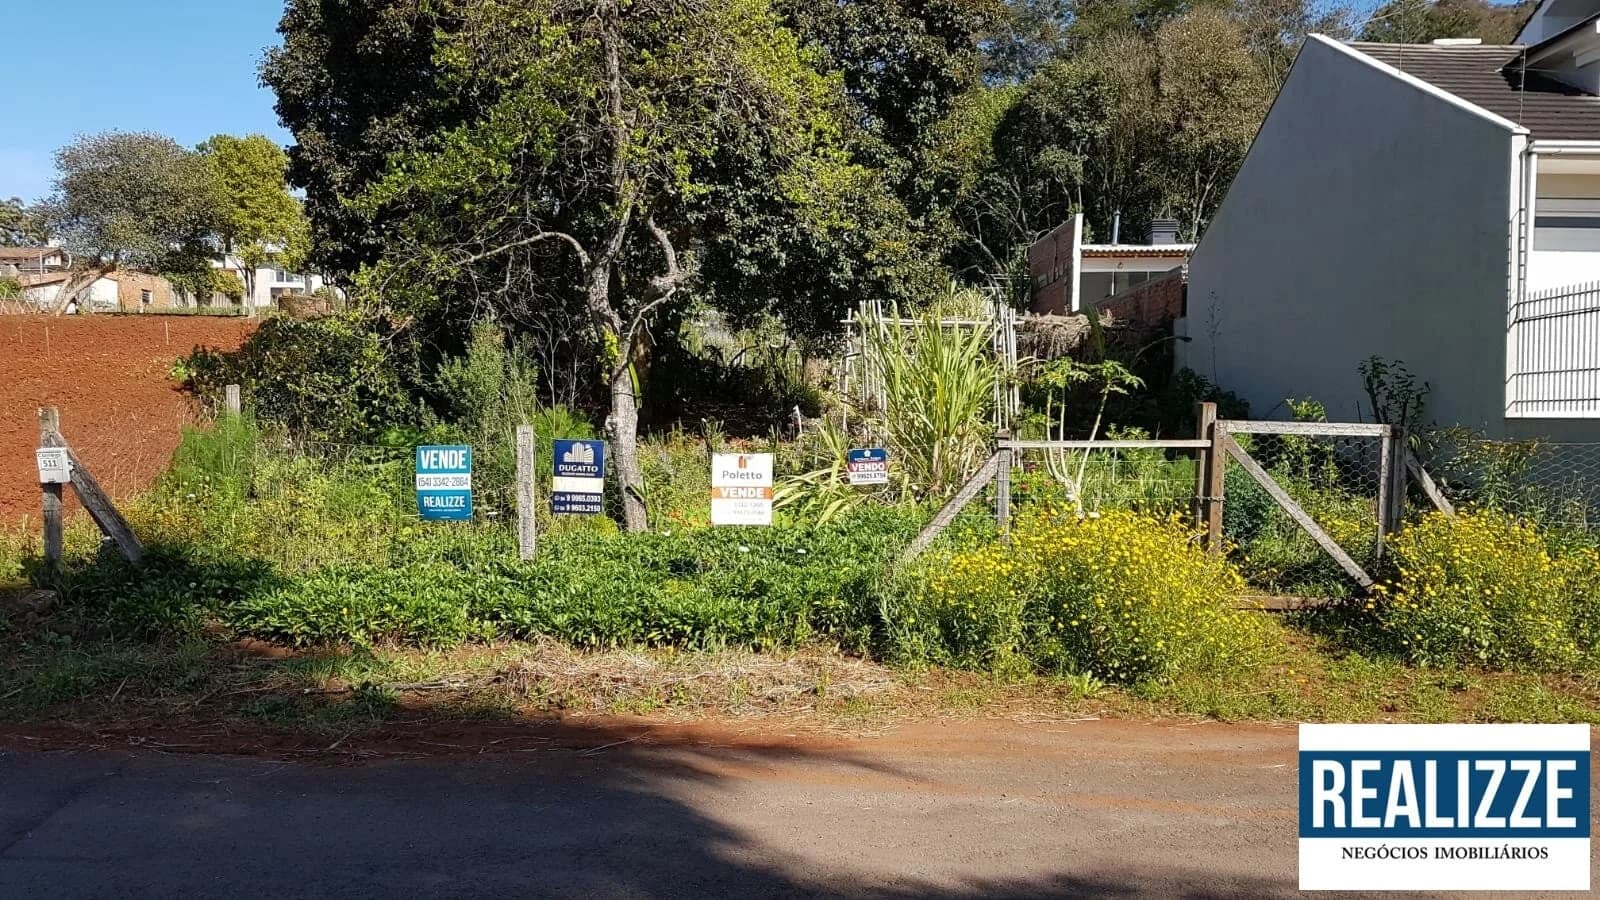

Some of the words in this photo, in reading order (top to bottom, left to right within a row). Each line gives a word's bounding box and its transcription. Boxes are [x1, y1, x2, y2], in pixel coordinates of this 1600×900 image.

[420, 449, 467, 469] VENDE
[559, 464, 598, 473] DUGATTO
[851, 462, 885, 471] VENDO
[722, 470, 763, 480] Poletto
[720, 487, 764, 498] VENDE
[423, 495, 465, 508] REALIZZE
